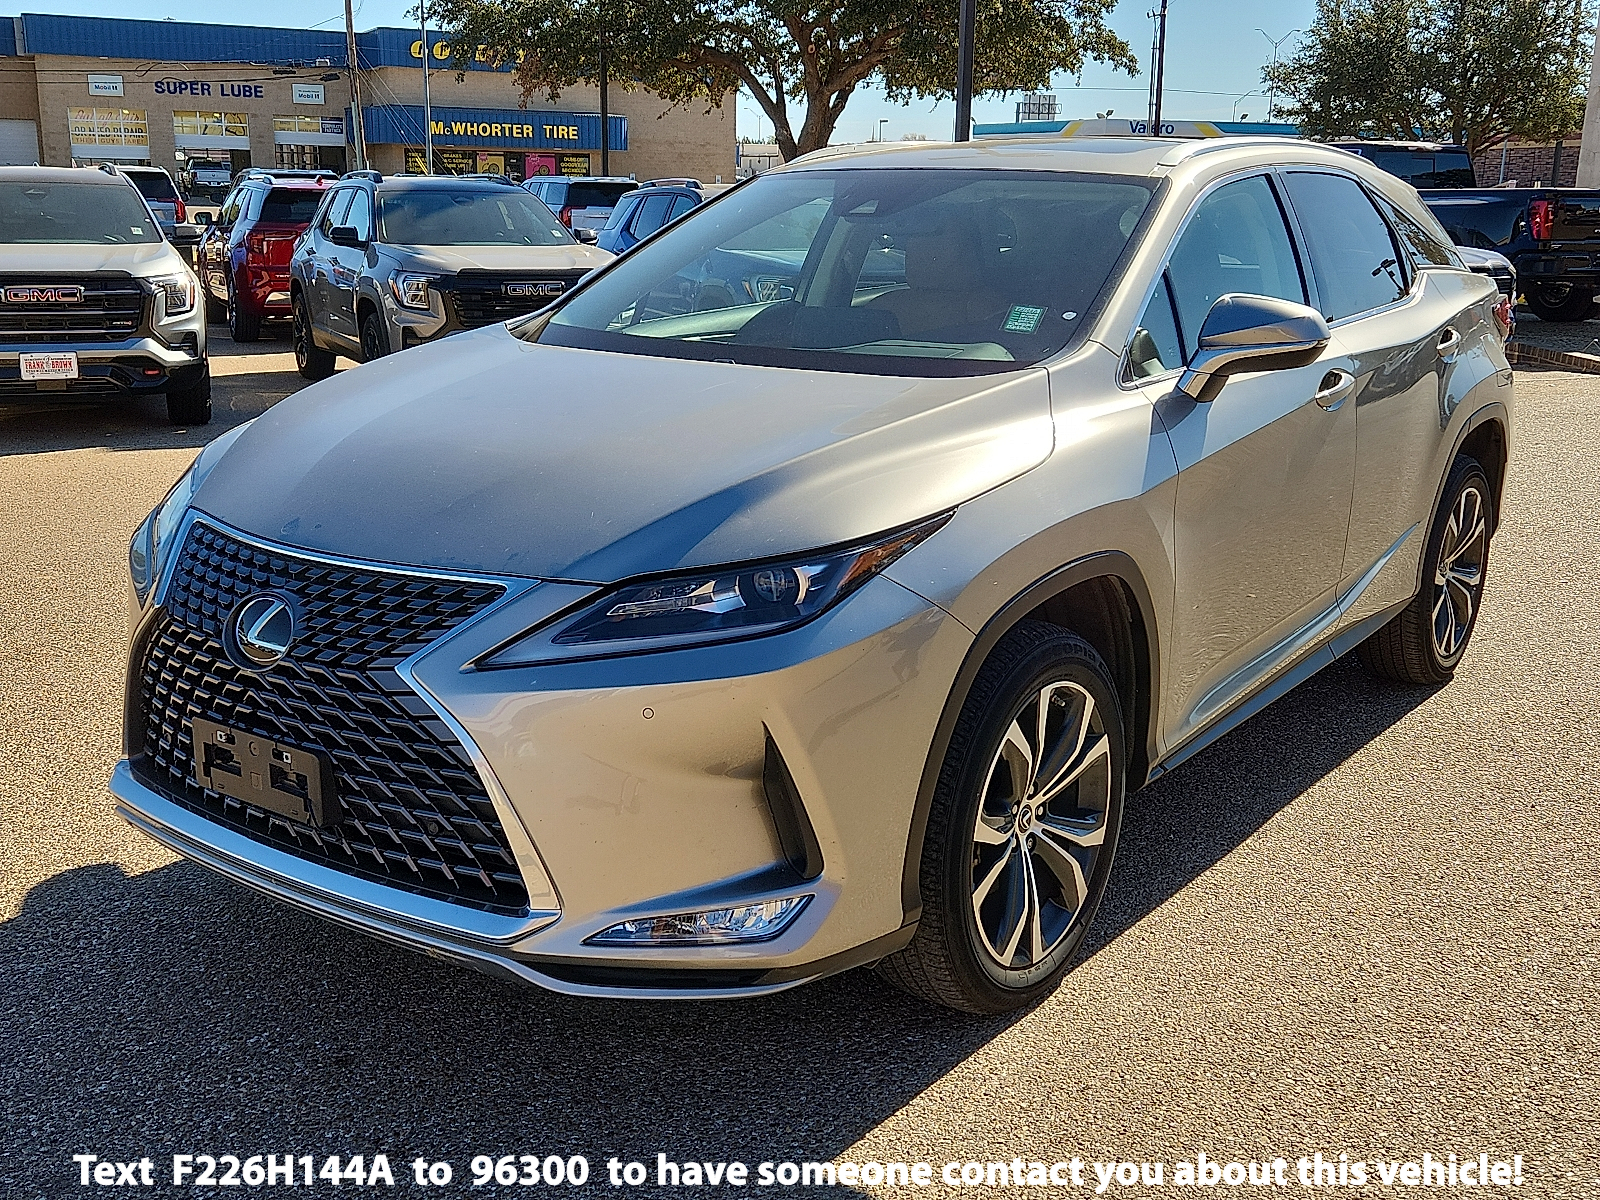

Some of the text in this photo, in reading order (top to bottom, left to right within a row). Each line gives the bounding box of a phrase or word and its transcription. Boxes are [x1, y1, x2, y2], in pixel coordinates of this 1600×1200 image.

[154, 80, 264, 99] SUPER LUBE
[430, 121, 579, 140] McWHORTER TIRE
[6, 287, 79, 302] GMC
[507, 283, 563, 296] GMC
[24, 360, 73, 370] FRANK BROWN
